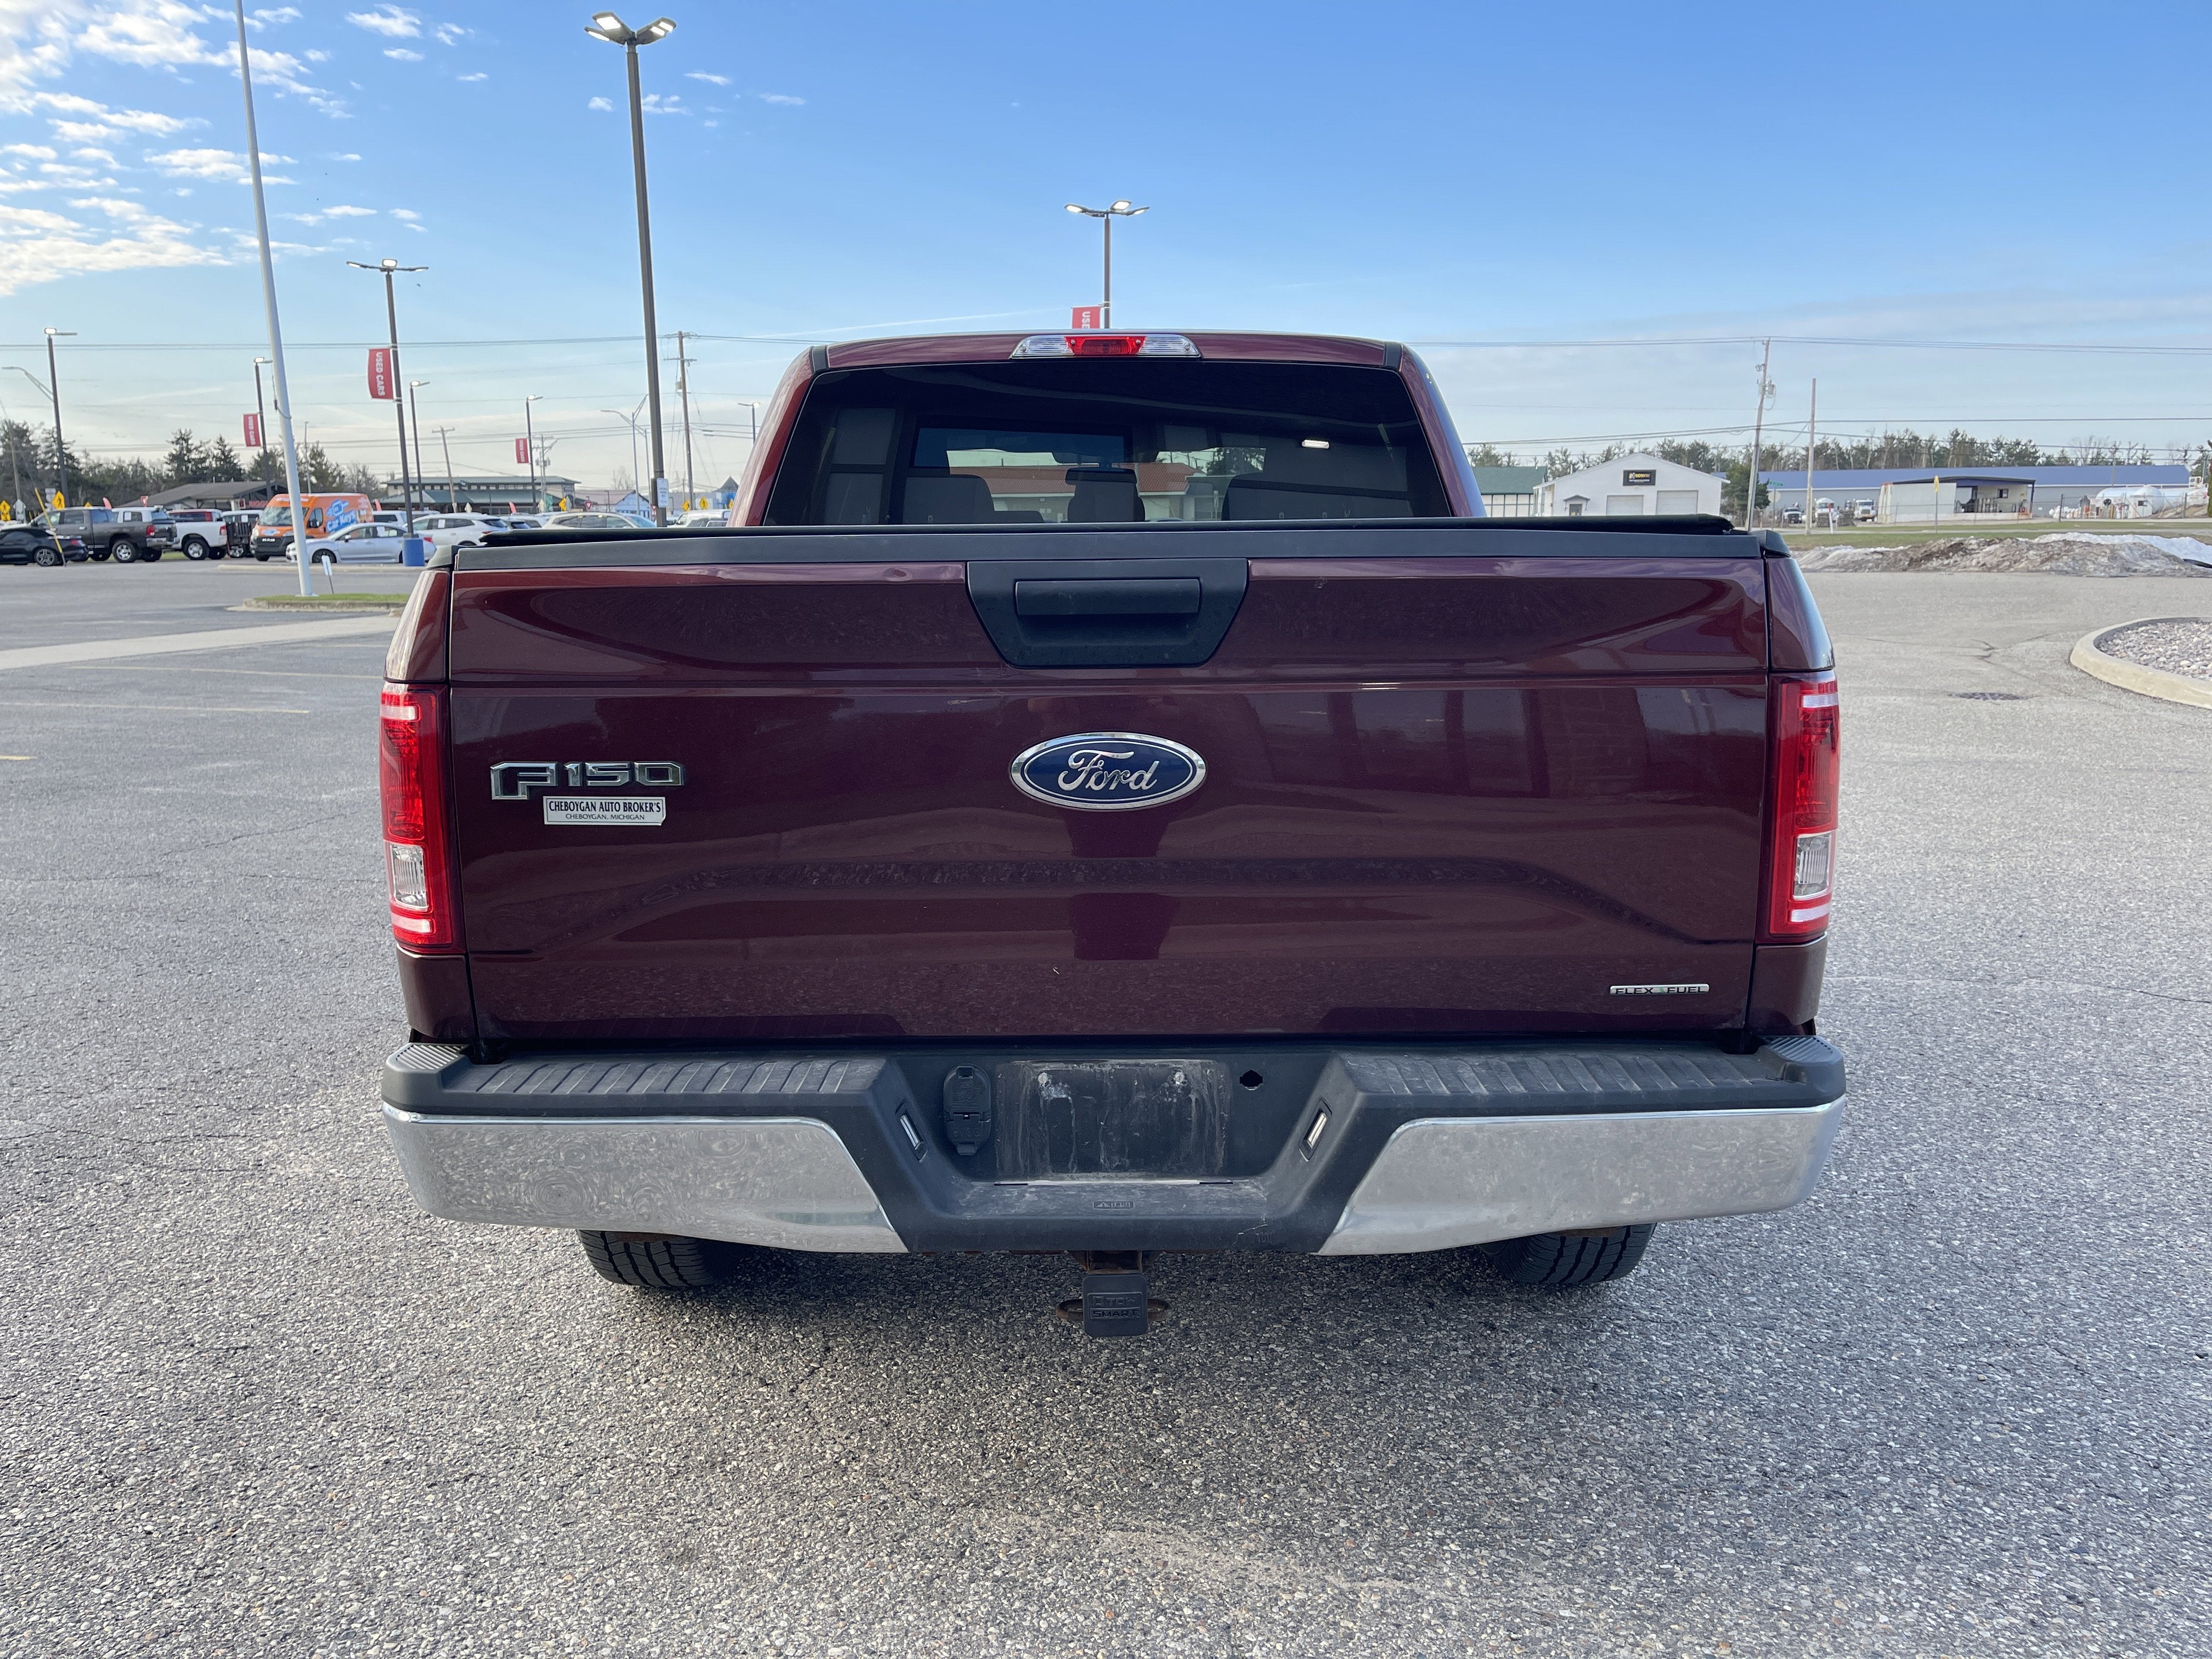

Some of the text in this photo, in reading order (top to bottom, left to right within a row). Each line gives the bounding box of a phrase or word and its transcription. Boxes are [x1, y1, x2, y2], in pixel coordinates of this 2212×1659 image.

[1082, 311, 1091, 329] USE
[375, 352, 386, 396] USED CARS
[1057, 749, 1160, 791] Ford
[549, 800, 661, 812] CHEBOYGAN AUTO BROKER'S
[1093, 1309, 1138, 1317] SMART
